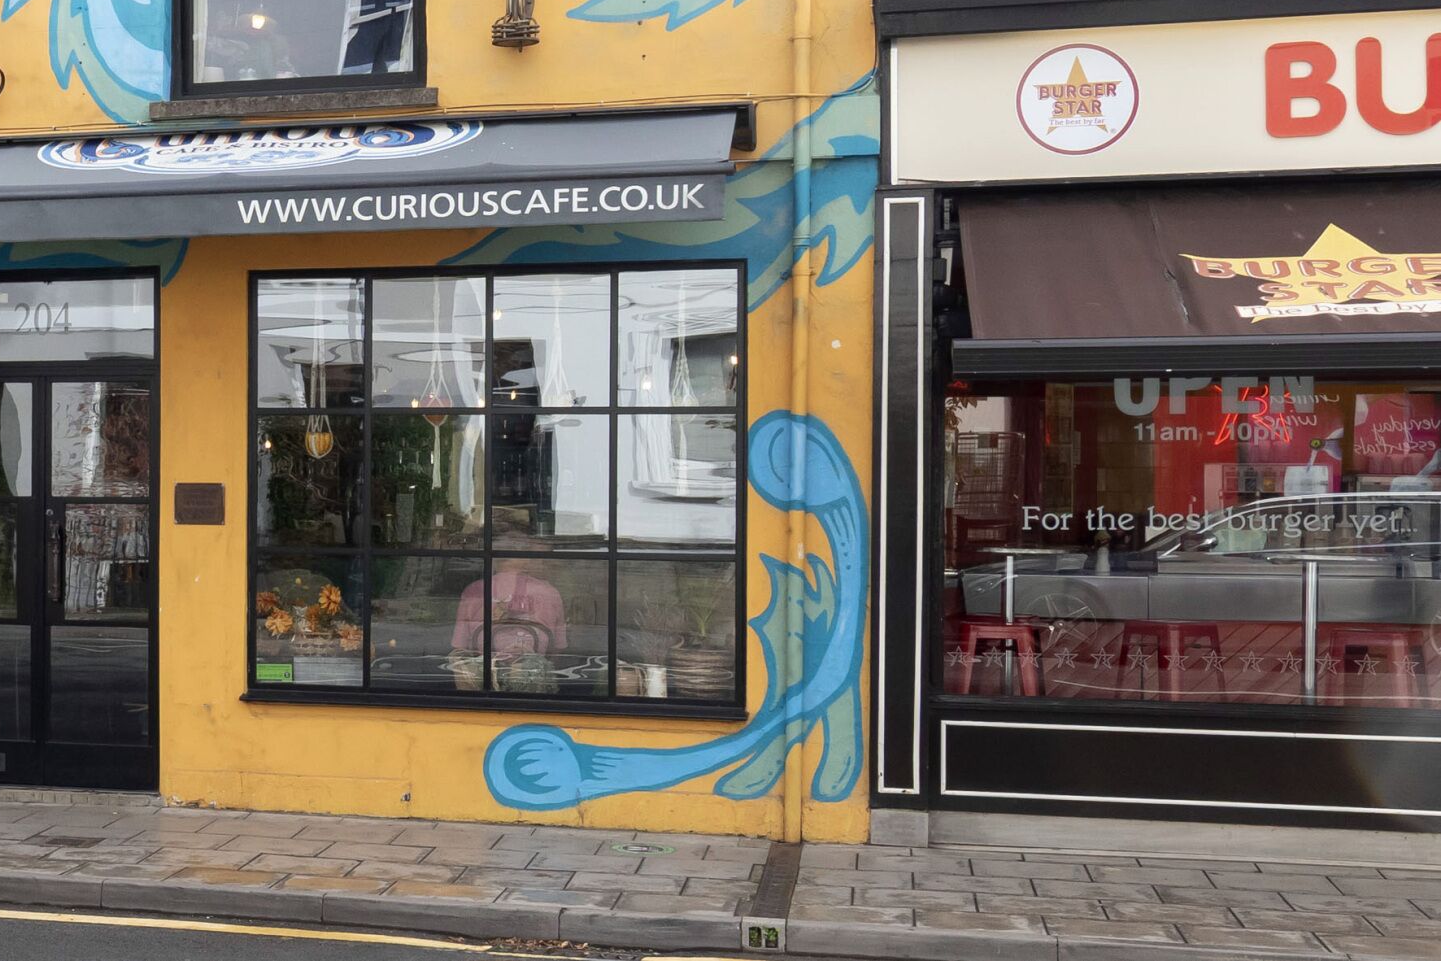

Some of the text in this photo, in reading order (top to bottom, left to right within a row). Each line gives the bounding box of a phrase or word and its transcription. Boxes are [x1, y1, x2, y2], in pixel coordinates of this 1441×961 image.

[1038, 83, 1117, 100] BURGER
[1053, 100, 1102, 115] STAR
[156, 146, 221, 155] CAFE
[252, 140, 349, 149] BISTRO
[237, 182, 706, 225] WWW.CURIOUSCAFE.CO.UK
[1243, 302, 1428, 316] The best by
[14, 302, 73, 335] 204
[1133, 422, 1198, 441] 11am
[1021, 506, 1074, 531] For
[1085, 506, 1135, 532] the
[1147, 506, 1211, 532] best
[1226, 507, 1336, 538] burger
